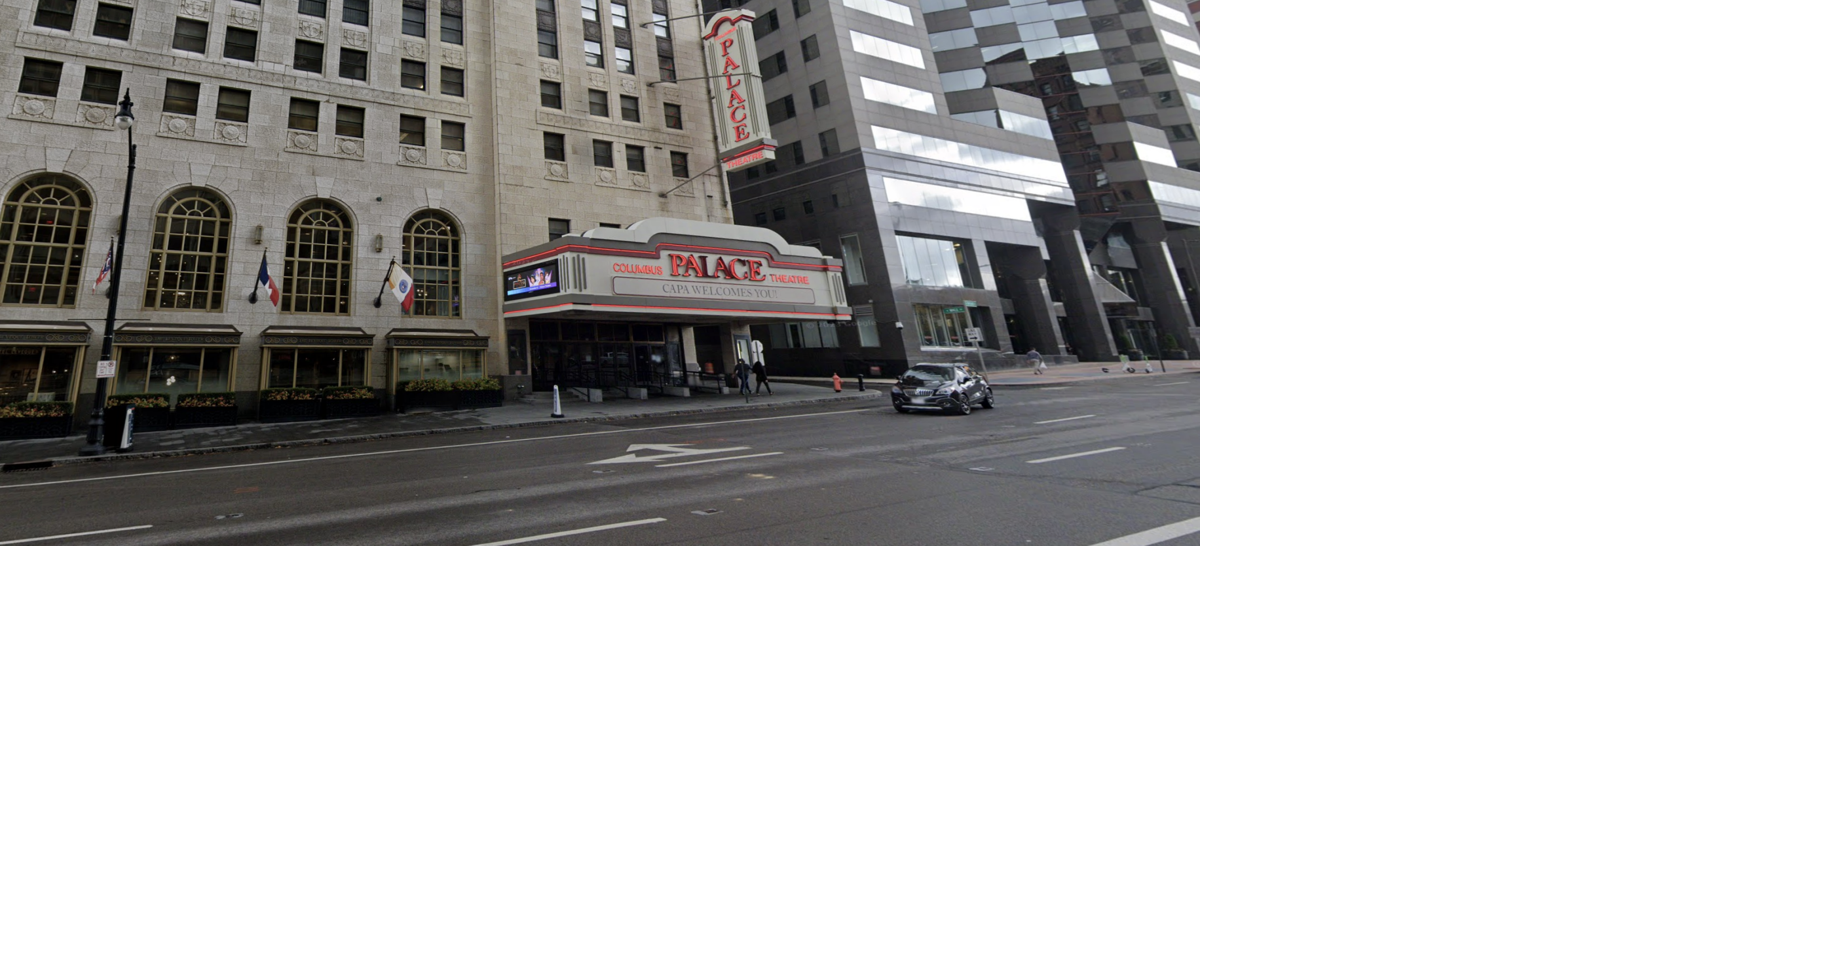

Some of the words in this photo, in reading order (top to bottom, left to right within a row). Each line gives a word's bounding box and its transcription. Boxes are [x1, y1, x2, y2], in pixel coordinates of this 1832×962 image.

[720, 37, 750, 143] PALACE
[727, 151, 764, 169] THEATRE
[613, 262, 664, 276] COLUMBUS
[668, 253, 766, 282] PALACE
[769, 273, 810, 285] THEATRE
[662, 283, 690, 295] CAPA
[691, 285, 753, 298] WELCOMES
[754, 288, 779, 299] YOU!
